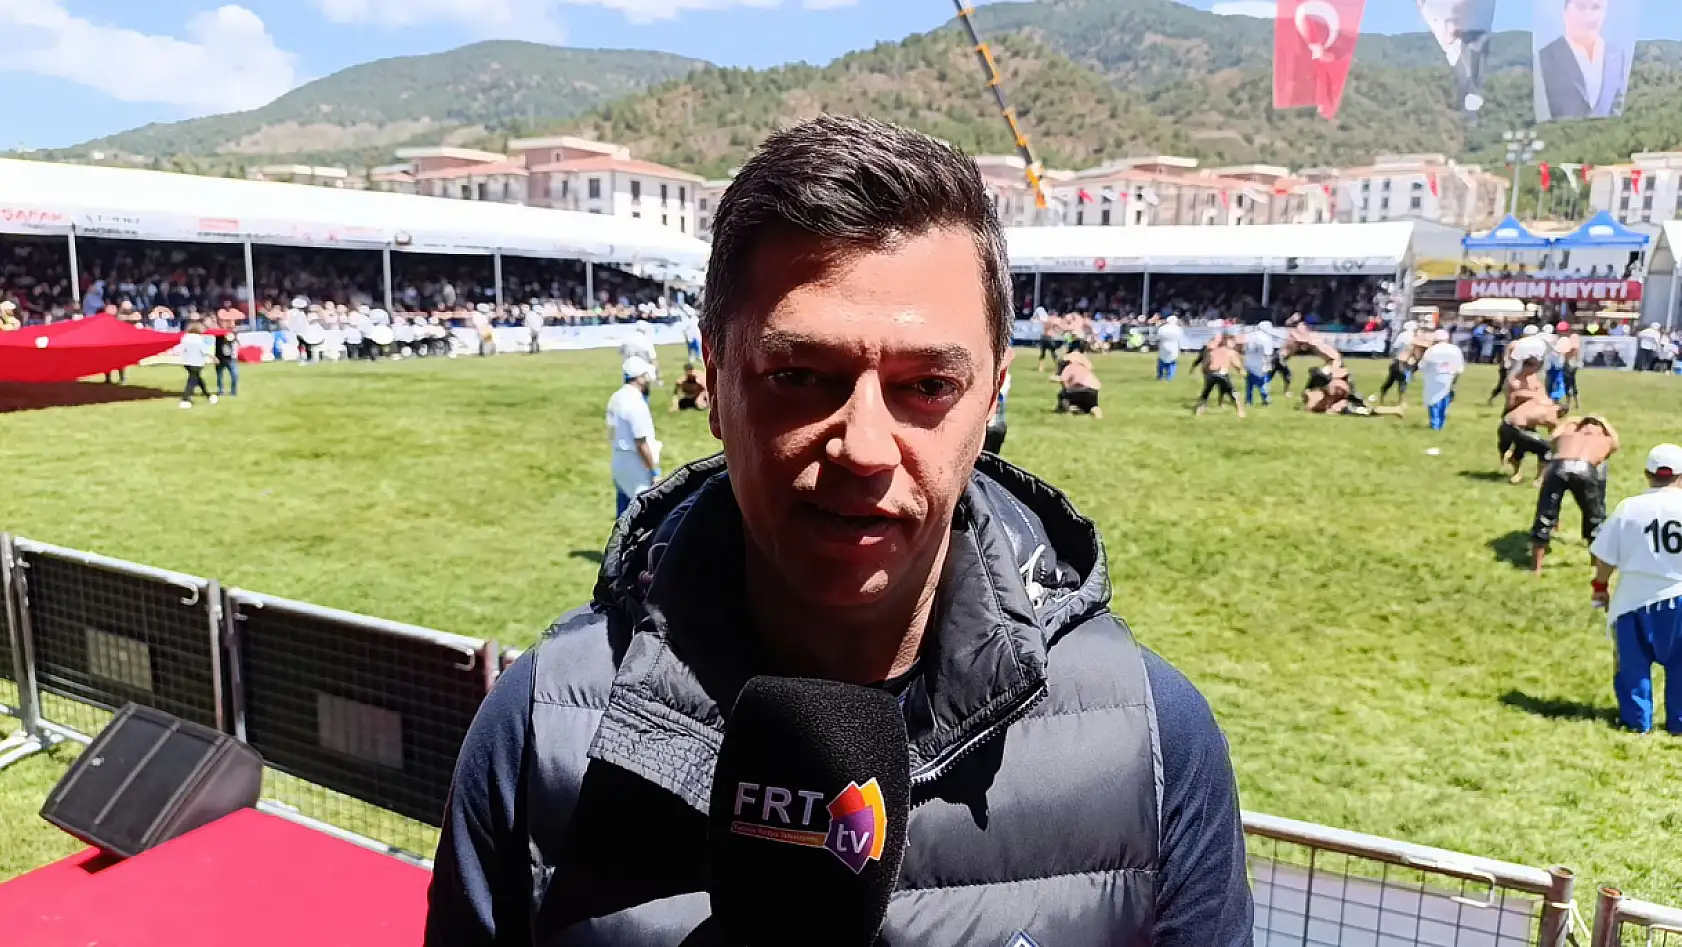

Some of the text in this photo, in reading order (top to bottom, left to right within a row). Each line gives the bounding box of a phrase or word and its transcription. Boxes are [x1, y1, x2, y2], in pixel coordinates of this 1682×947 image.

[1470, 280, 1628, 299] HAKEM HEYETİ
[1643, 518, 1682, 554] 16
[734, 782, 824, 825] FRT
[836, 823, 870, 853] tv
